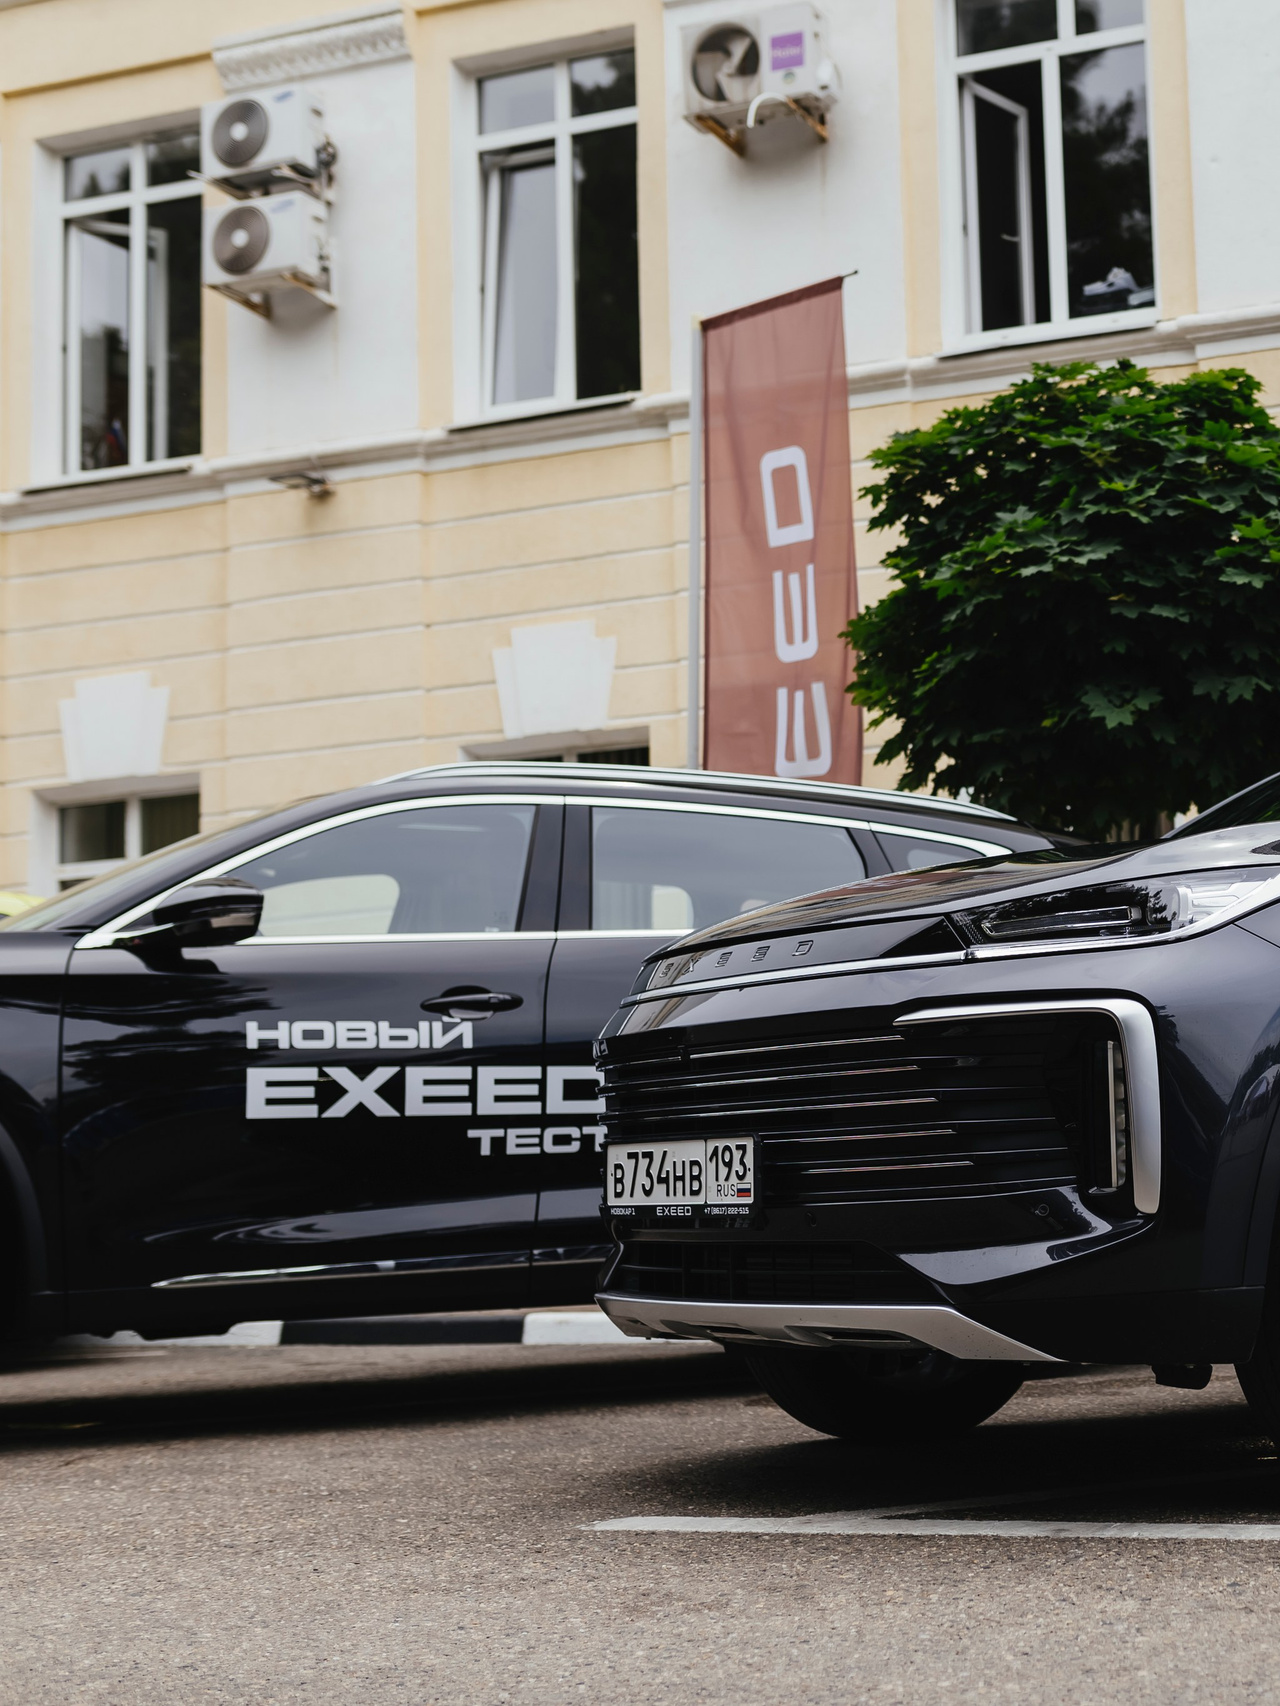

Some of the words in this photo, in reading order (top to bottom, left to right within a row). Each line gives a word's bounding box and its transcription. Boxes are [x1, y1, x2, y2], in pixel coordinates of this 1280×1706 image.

[245, 1015, 473, 1050] НОВЫЙ
[245, 1065, 605, 1119] EXEED
[708, 1142, 748, 1182] 193
[716, 1184, 736, 1198] RUS
[656, 1206, 692, 1216] EXEED
